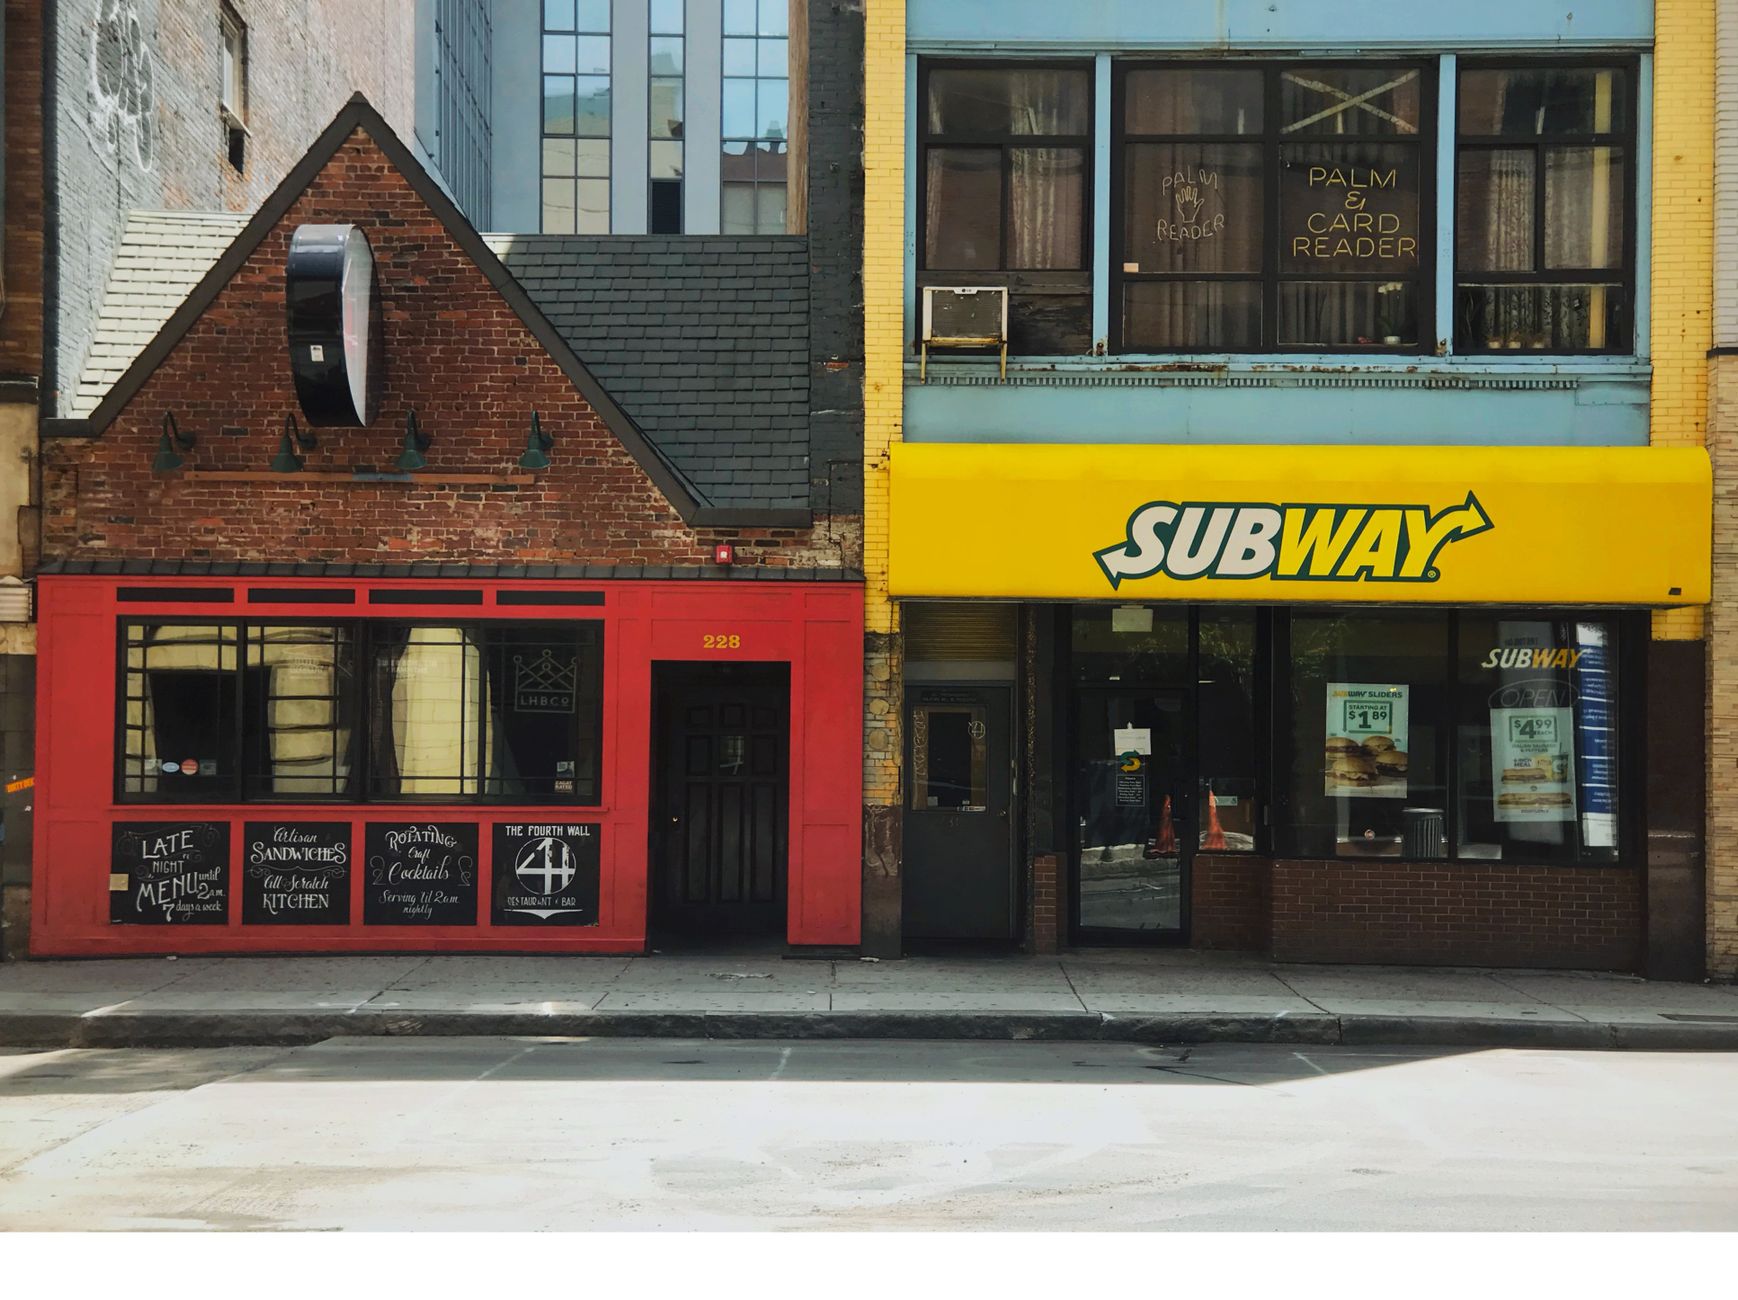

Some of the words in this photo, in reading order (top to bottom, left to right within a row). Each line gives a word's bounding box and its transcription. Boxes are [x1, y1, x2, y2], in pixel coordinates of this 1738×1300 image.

[1162, 165, 1218, 196] PALM
[1308, 166, 1397, 190] PALM
[1344, 190, 1366, 212] &
[1157, 213, 1225, 242] READER
[1307, 212, 1400, 235] CARD
[1292, 236, 1417, 259] READER
[1092, 494, 1494, 589] SUBWAY
[703, 634, 741, 649] 228
[1481, 647, 1584, 670] SUBWAY
[1368, 691, 1403, 699] SLIDERS
[1500, 687, 1568, 708] OPEN
[273, 826, 318, 843] Artisan
[384, 825, 458, 852] ROTATING
[505, 825, 524, 837] THE
[527, 825, 563, 837] FOURTH
[567, 825, 591, 837] WALL
[142, 829, 194, 859] LATE
[250, 841, 347, 865] SANDWICHES
[408, 846, 431, 864] Craft
[152, 860, 185, 874] NIGHT
[198, 866, 221, 881] until
[388, 855, 449, 885] Cocktails
[136, 871, 199, 912] MENU
[263, 874, 283, 889] All
[284, 874, 329, 892] Scratch
[262, 893, 329, 915] KITCHEN
[382, 889, 416, 906] Serving
[561, 896, 577, 907] BAR
[162, 903, 176, 922] 7
[175, 899, 195, 921] days
[402, 903, 433, 920] nightly
